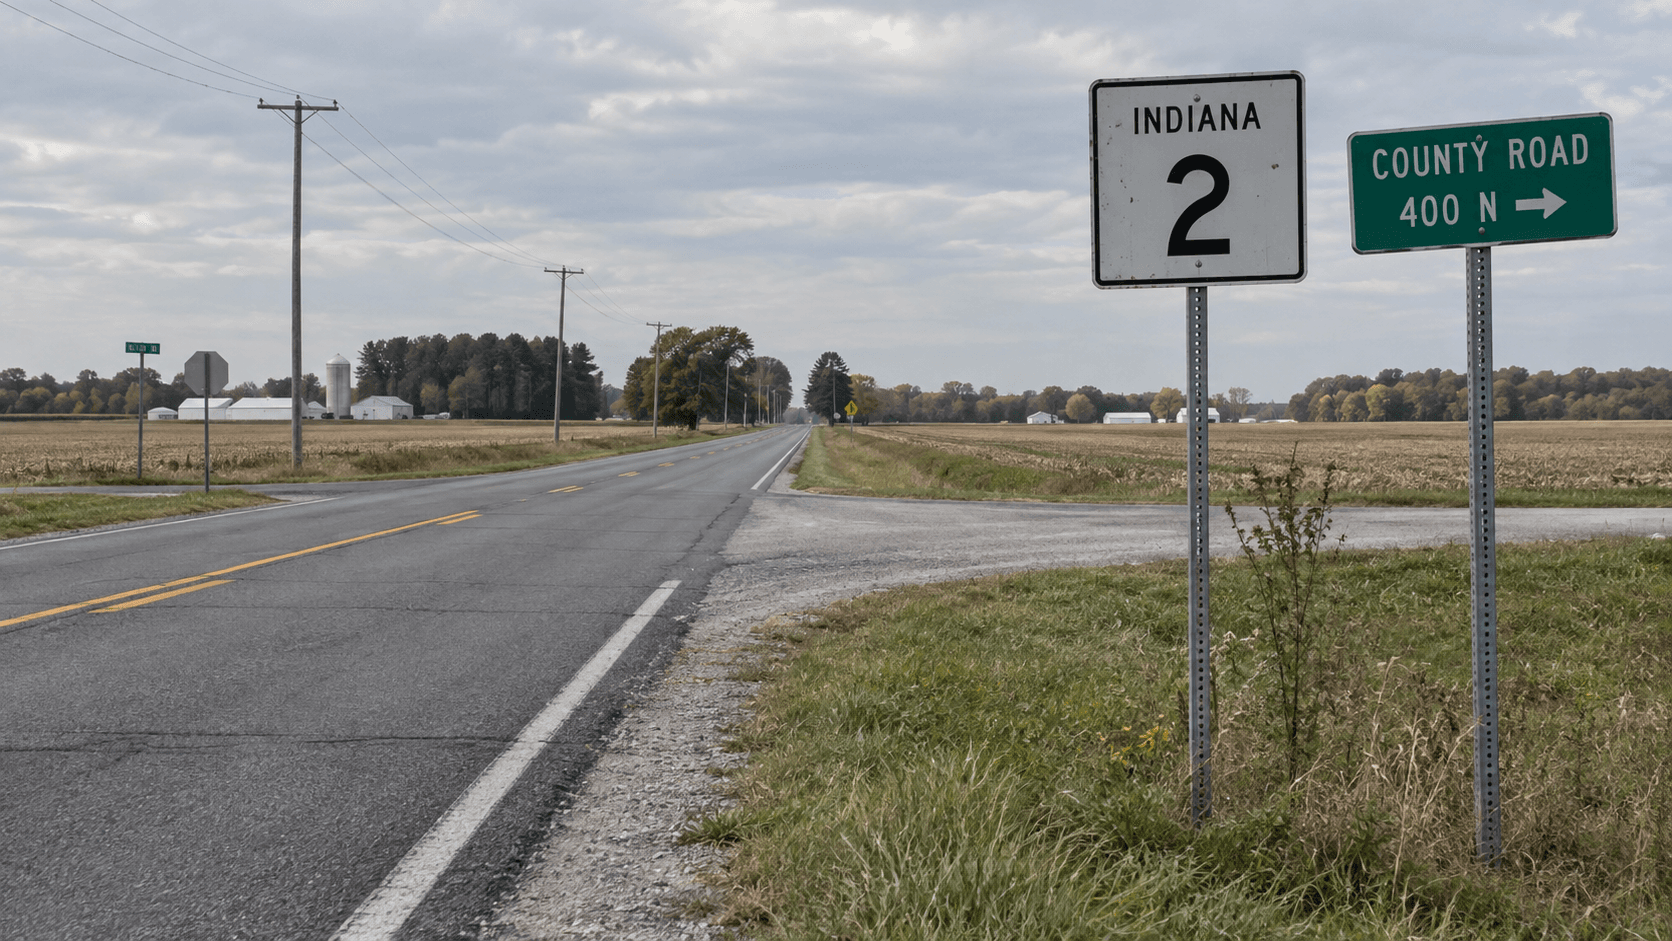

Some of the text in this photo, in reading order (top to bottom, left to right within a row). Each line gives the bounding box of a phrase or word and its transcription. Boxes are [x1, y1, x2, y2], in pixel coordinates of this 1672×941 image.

[1133, 102, 1261, 135] INDIANA
[1372, 134, 1588, 180] COUNTY ROAD
[1167, 154, 1231, 256] 2
[1400, 191, 1497, 228] 400 N
